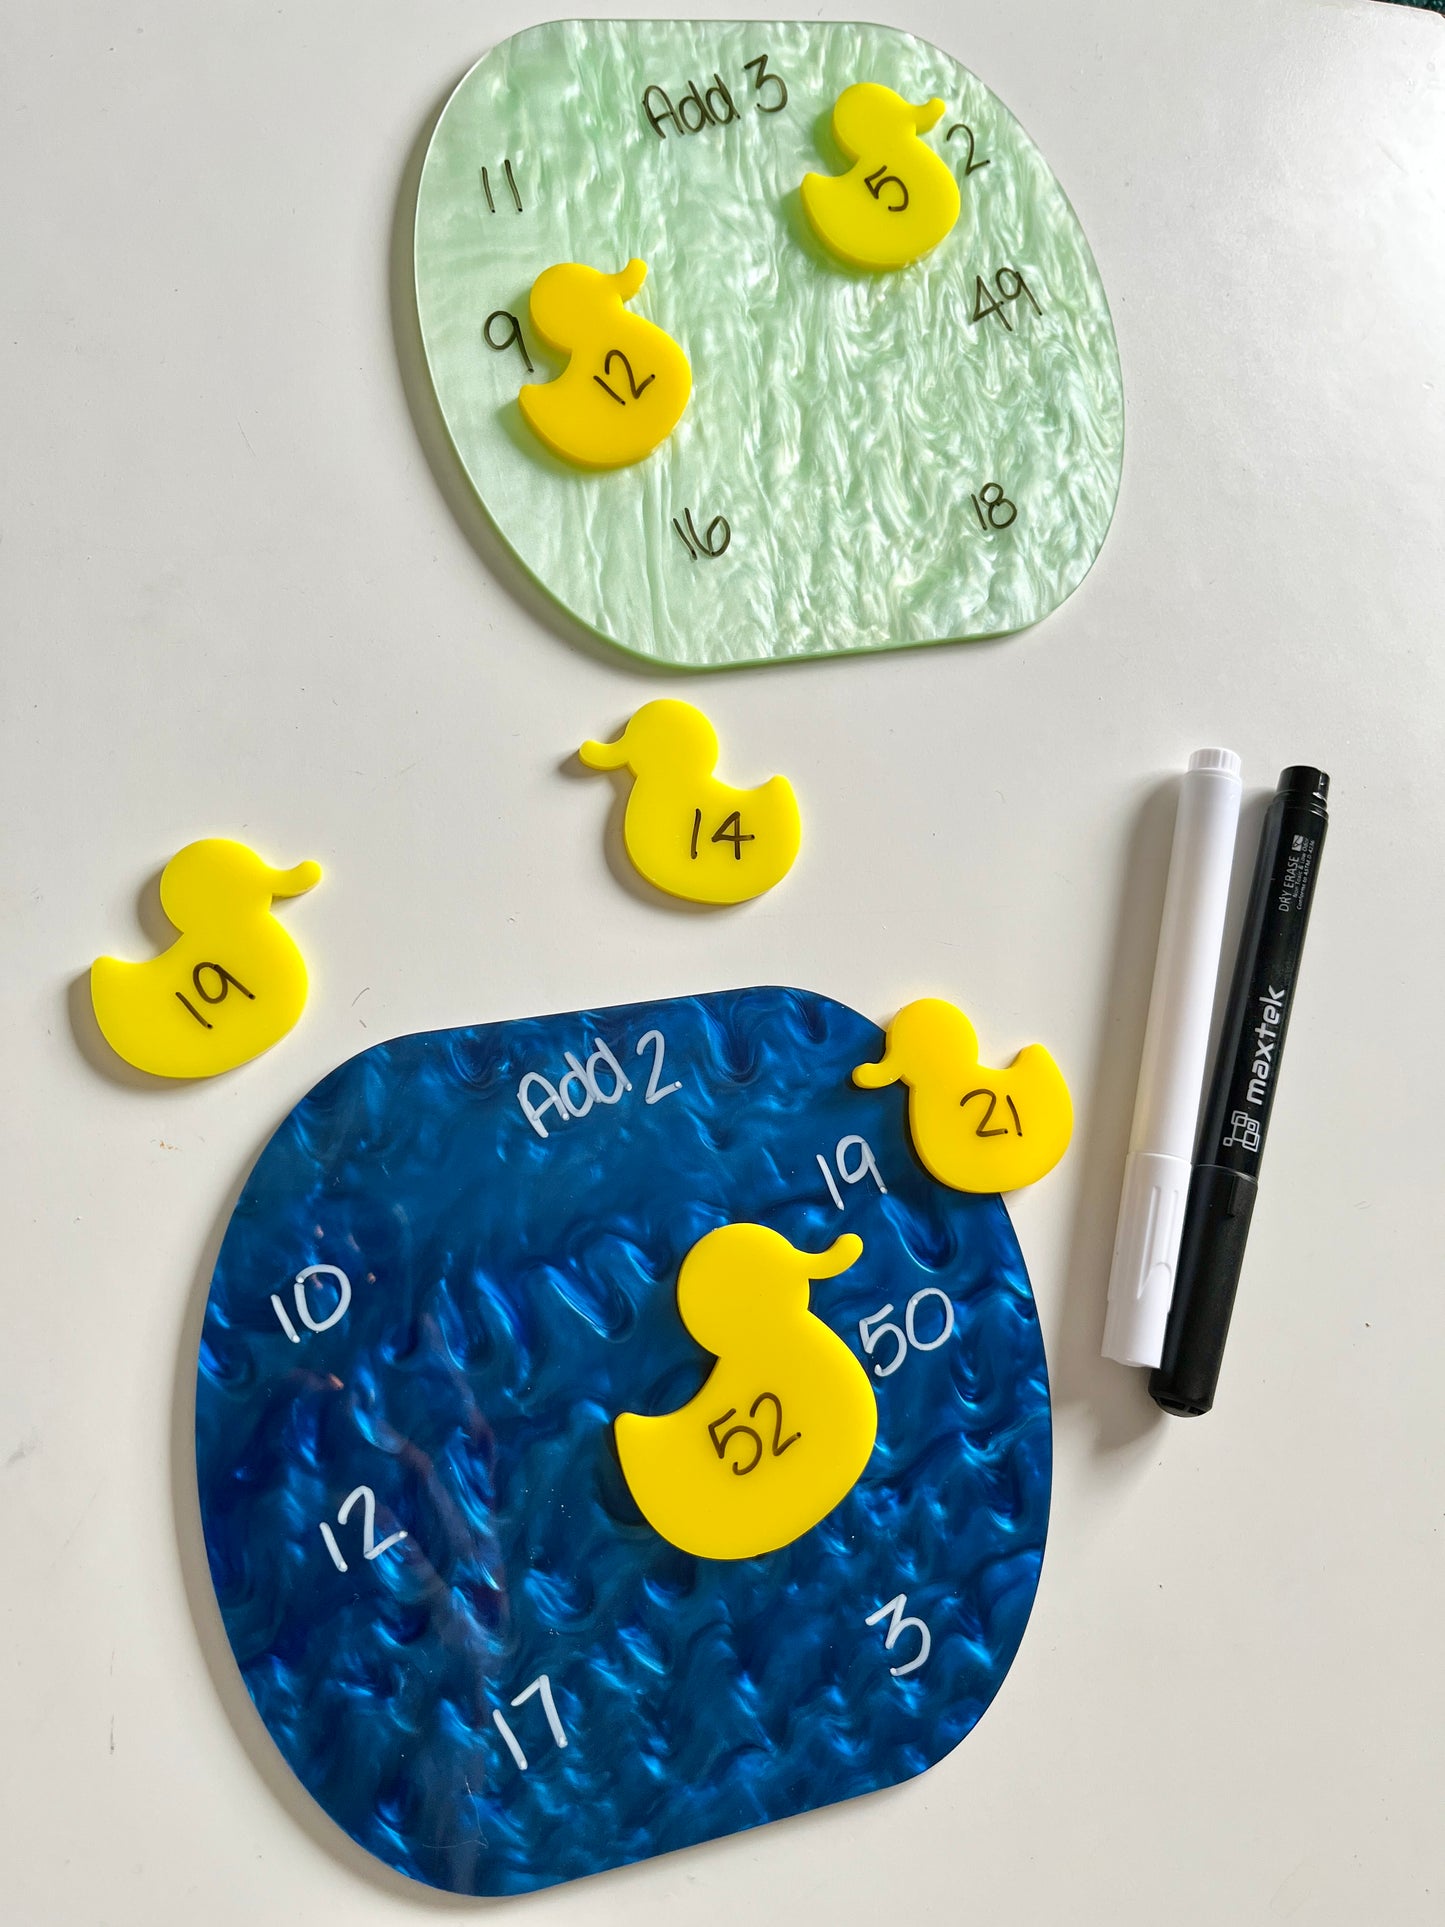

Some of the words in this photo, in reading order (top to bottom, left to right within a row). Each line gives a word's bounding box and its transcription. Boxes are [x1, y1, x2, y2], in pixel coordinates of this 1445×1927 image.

[642, 74, 740, 138] Add
[744, 54, 789, 112] 3
[946, 123, 991, 175] 2
[481, 158, 523, 213] 11
[863, 164, 910, 212] 5
[972, 267, 1043, 331] 49
[483, 310, 534, 373] 9
[593, 349, 656, 405] 12
[673, 507, 731, 560] 16
[970, 482, 1018, 531] 18
[691, 807, 755, 860] 14
[1278, 889, 1292, 912] DRY
[1283, 856, 1300, 888] ERASE
[175, 961, 255, 1030] 19
[1246, 985, 1285, 1105] maxtek
[517, 1037, 632, 1138] Add
[636, 1029, 683, 1105] 2
[960, 1088, 1023, 1138] 21
[816, 1134, 888, 1211] 19
[271, 1263, 352, 1343] 10
[859, 1287, 955, 1377] 50
[707, 1392, 802, 1476] 52
[319, 1485, 408, 1572] 12
[866, 1594, 933, 1677] 3
[492, 1674, 568, 1771] 17
